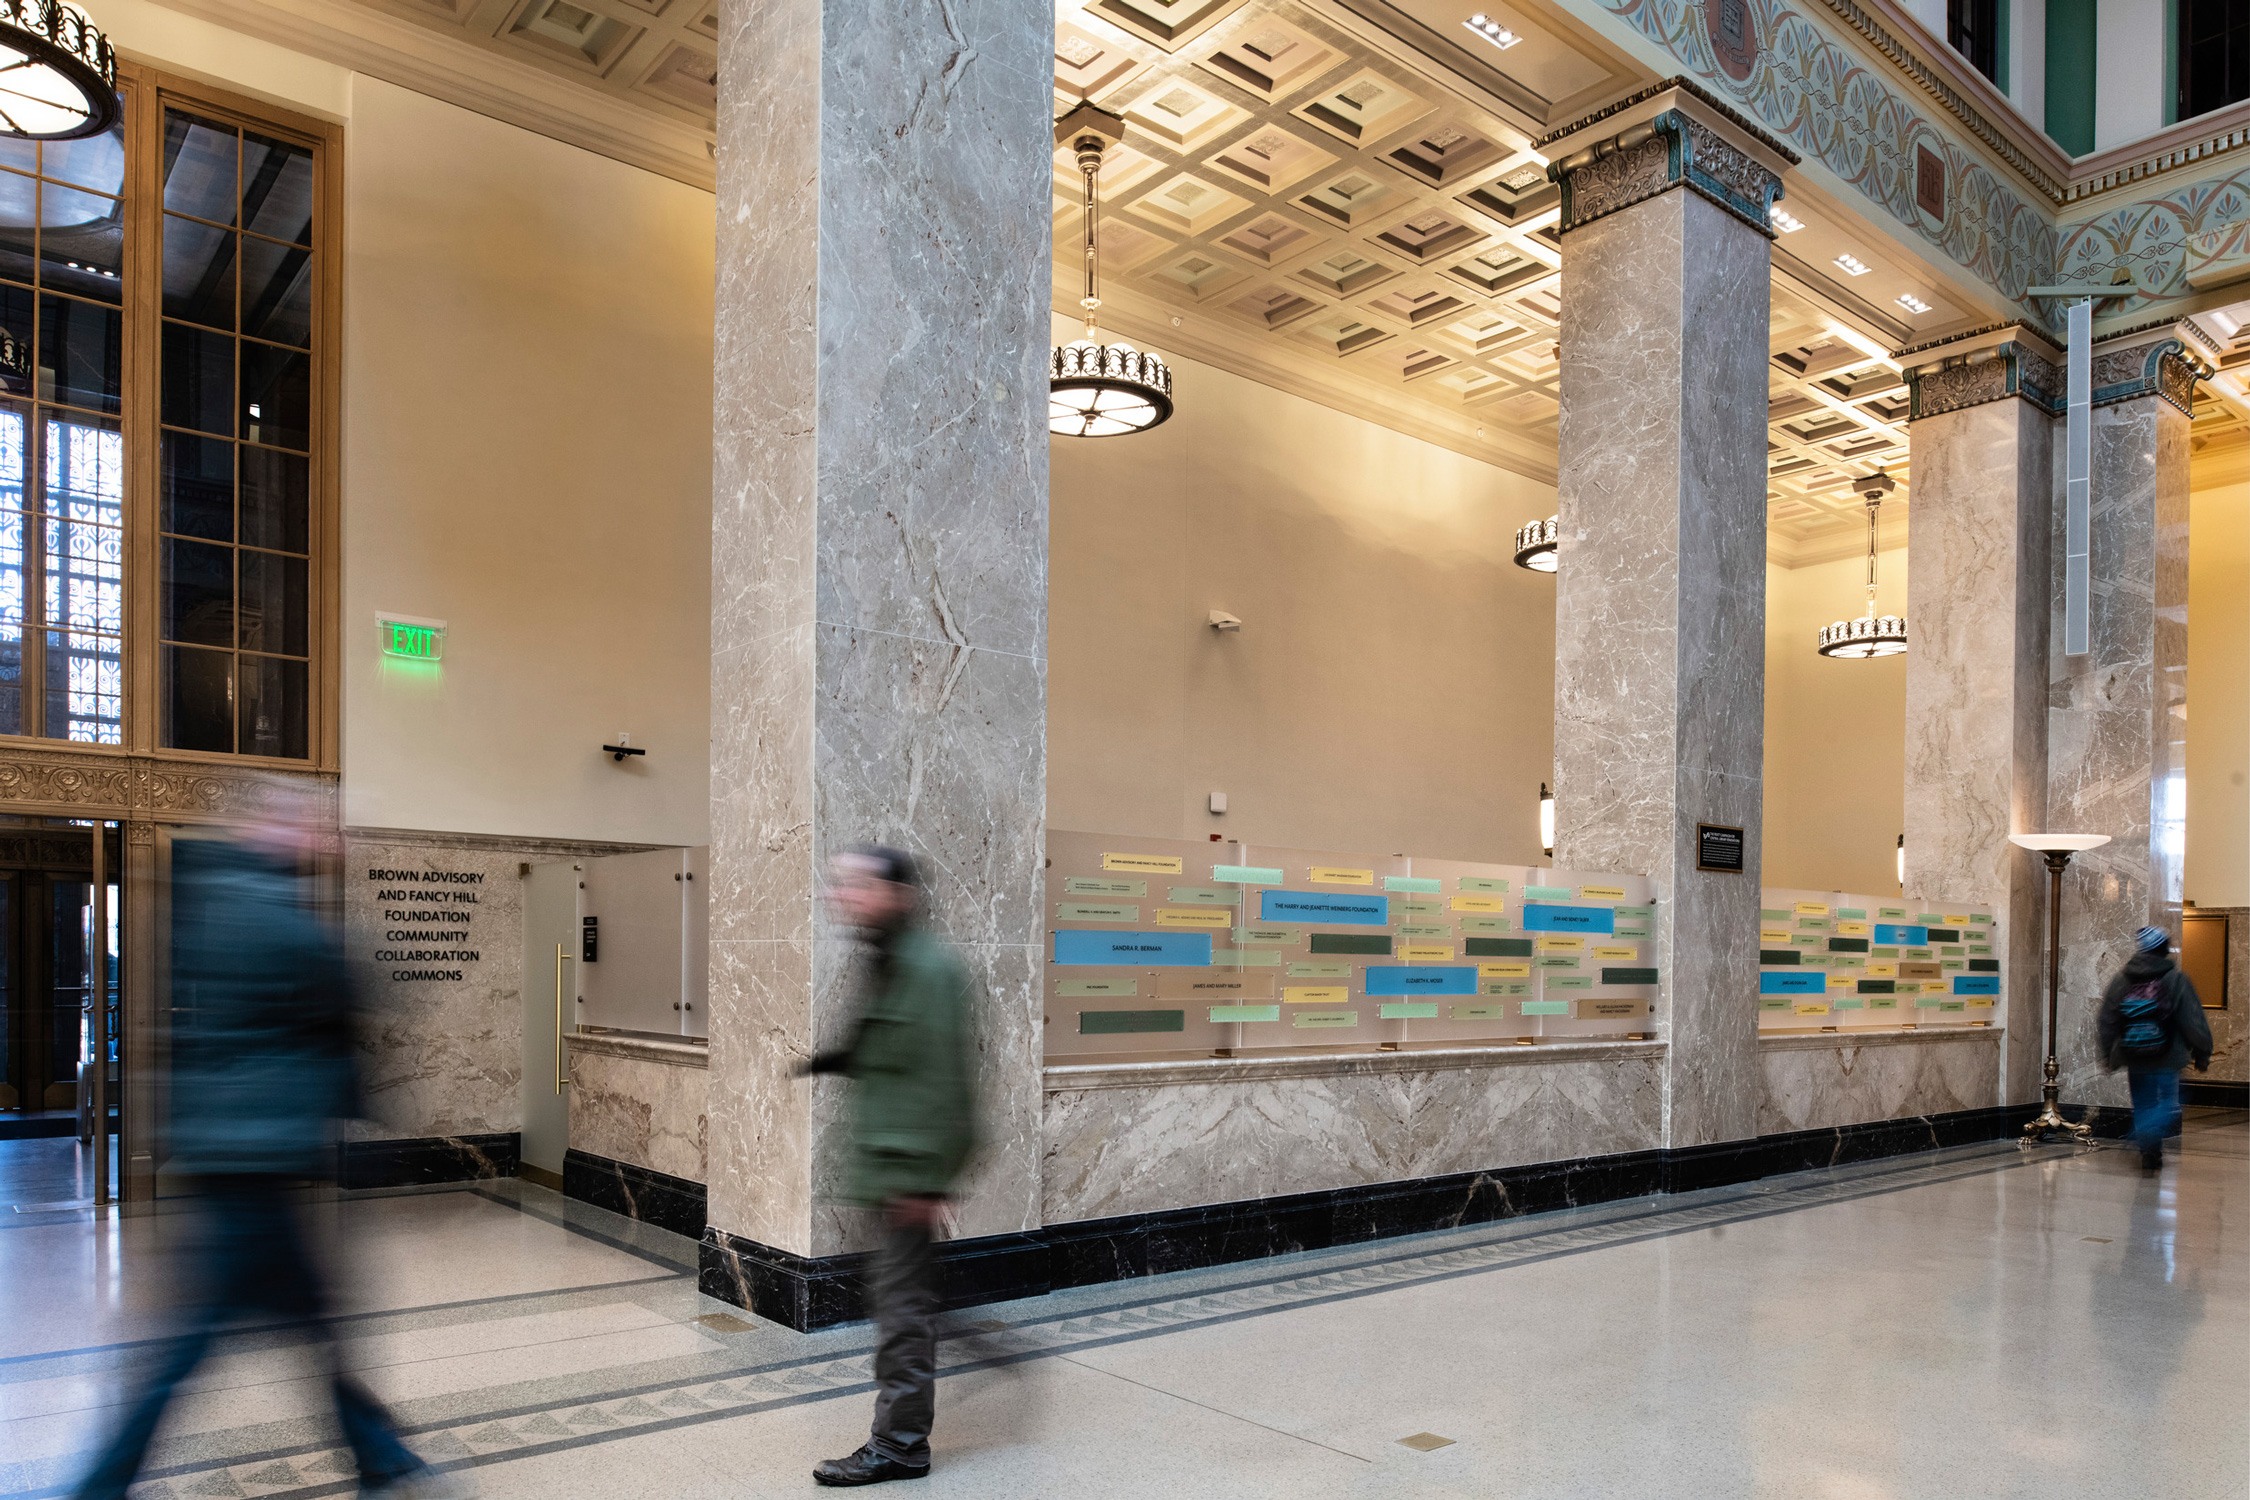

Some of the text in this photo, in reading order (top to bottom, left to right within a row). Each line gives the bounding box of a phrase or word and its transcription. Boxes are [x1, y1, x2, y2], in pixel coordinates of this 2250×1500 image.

[394, 625, 434, 657] EXIT
[369, 869, 484, 884] BROWN ADVISORY
[378, 890, 478, 903] AND FANCY HILL
[385, 910, 470, 922] FOUNDATION
[386, 930, 468, 942] COMMUNITY
[375, 950, 479, 961] COLLABORATION
[392, 970, 462, 981] COMMONS
